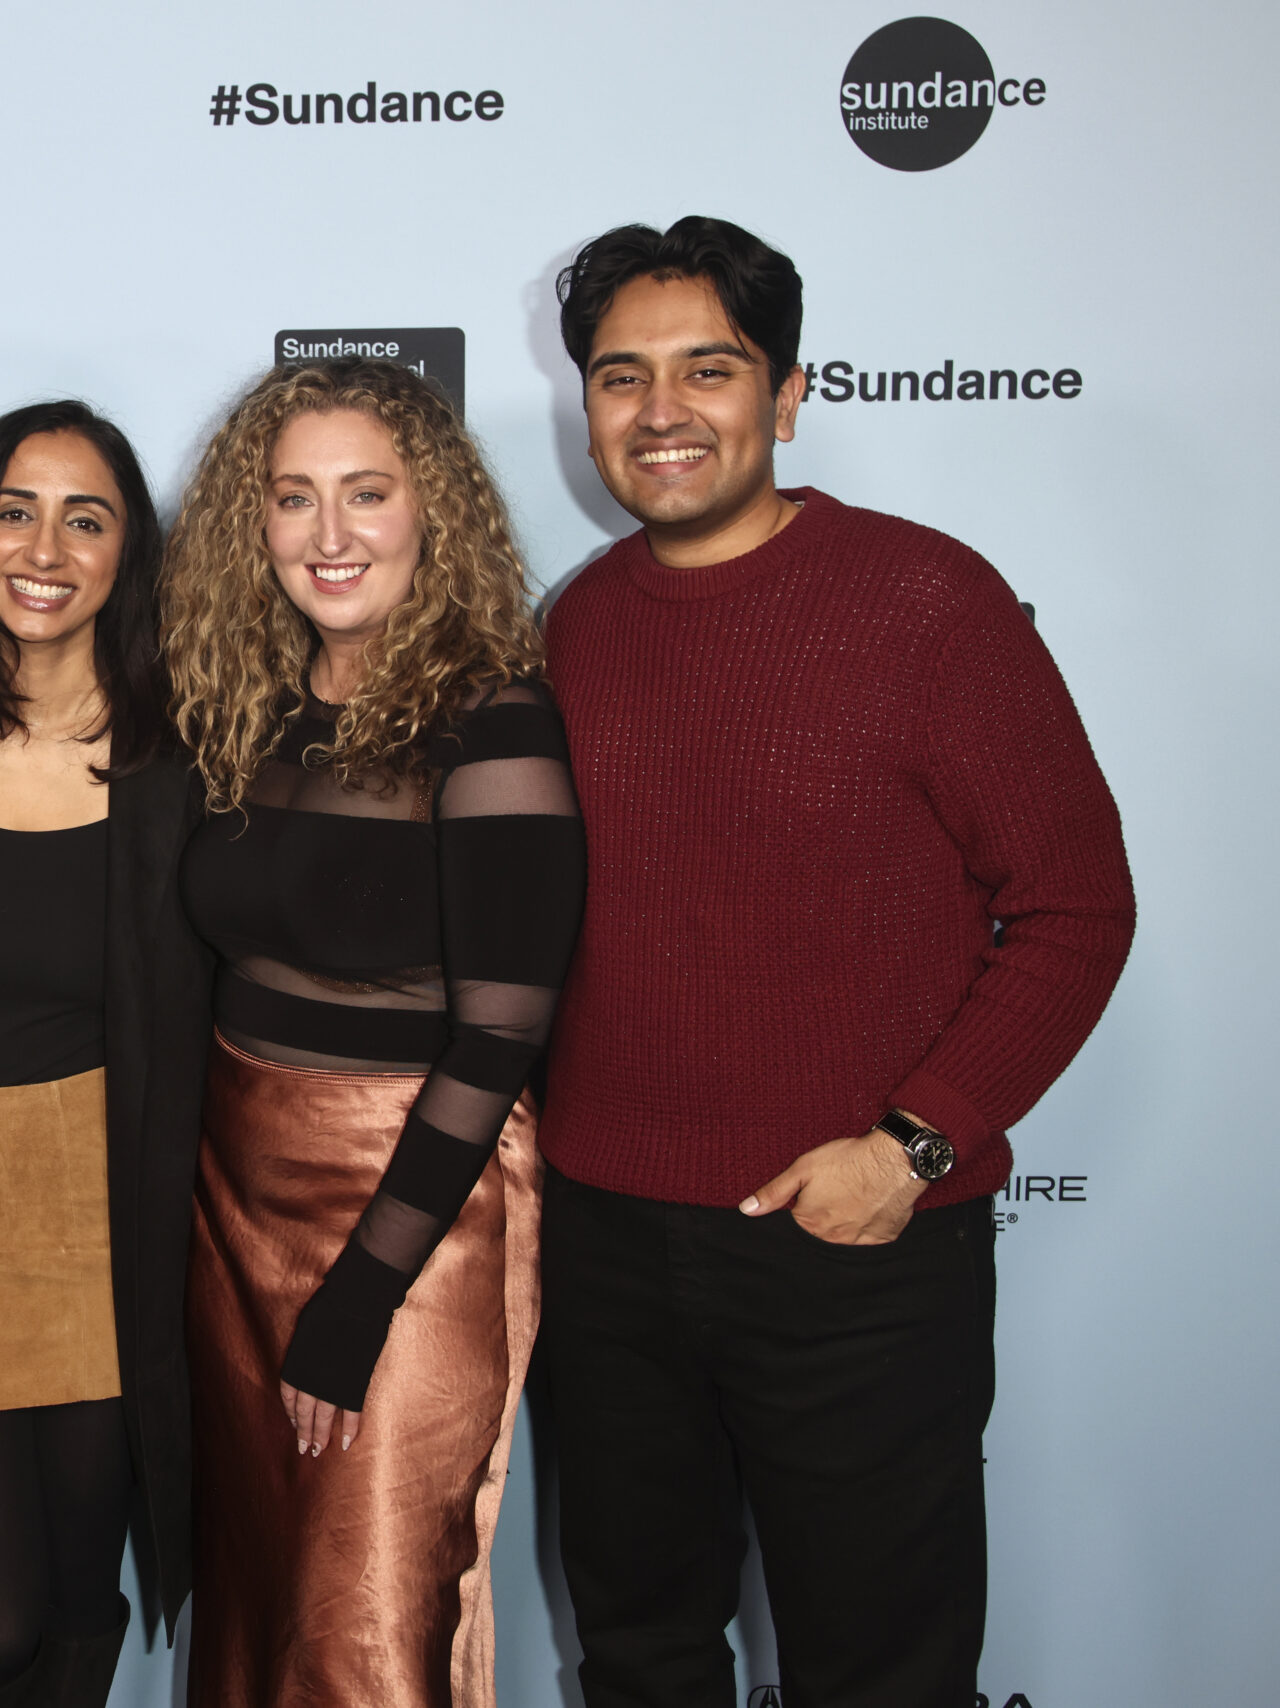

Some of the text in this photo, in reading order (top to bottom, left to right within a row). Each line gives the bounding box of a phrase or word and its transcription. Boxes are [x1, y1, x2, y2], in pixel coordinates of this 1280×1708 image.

[209, 81, 505, 126] #Sundance
[841, 71, 1047, 110] sundance
[849, 112, 929, 131] institute
[282, 337, 400, 359] Sundance
